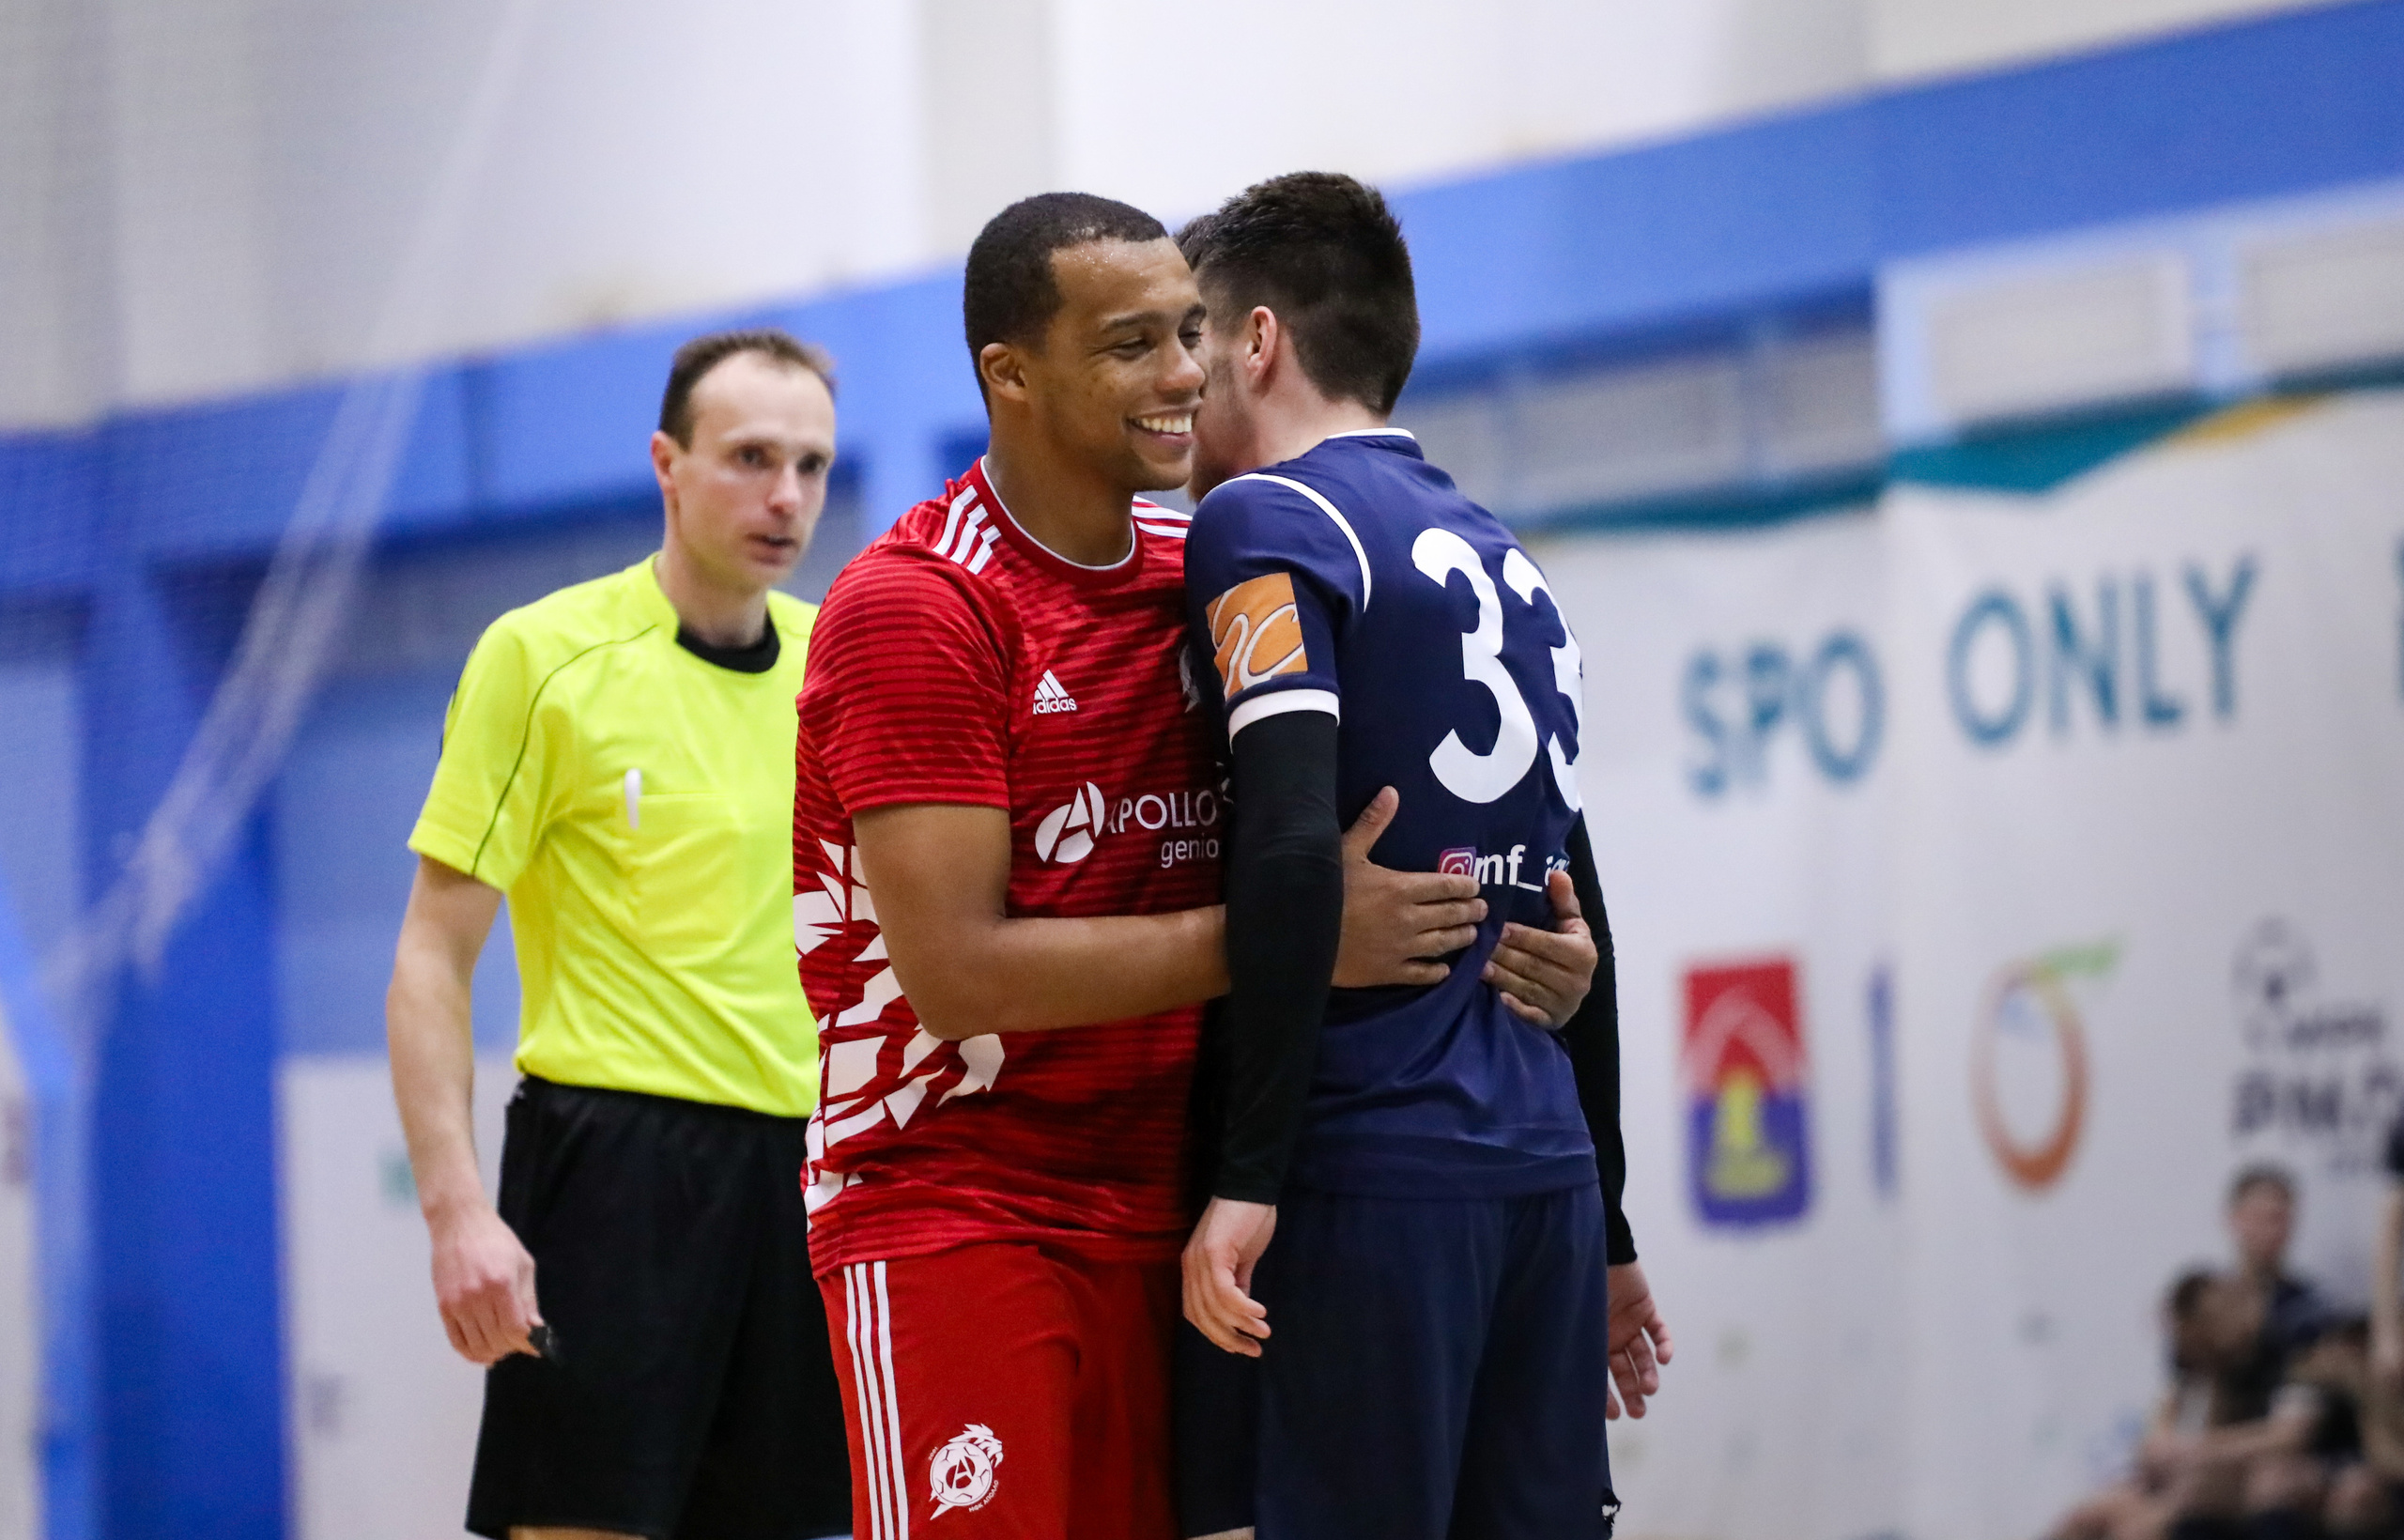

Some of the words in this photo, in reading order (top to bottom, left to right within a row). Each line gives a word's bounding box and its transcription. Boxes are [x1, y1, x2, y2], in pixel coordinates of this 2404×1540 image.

[1411, 527, 1583, 812] 33
[1947, 554, 2259, 748] ONLY
[1161, 833, 1219, 869] genio
